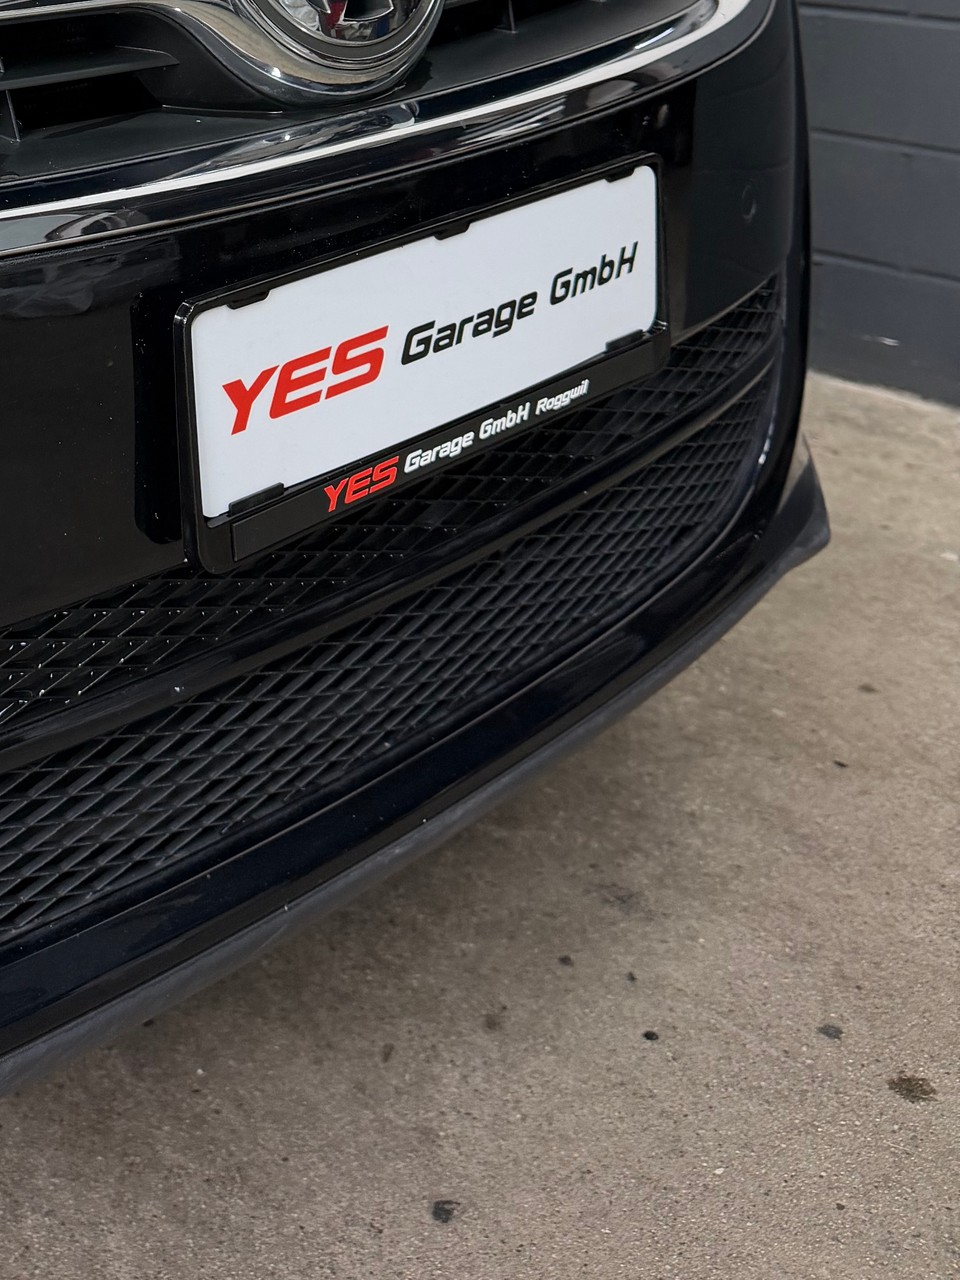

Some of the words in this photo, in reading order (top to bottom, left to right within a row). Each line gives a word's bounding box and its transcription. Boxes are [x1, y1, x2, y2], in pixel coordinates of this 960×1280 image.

[222, 325, 389, 435] YES
[401, 291, 538, 366] Garage
[550, 241, 639, 306] GmbH
[324, 455, 399, 513] YES
[403, 431, 475, 474] Garage
[478, 401, 531, 440] GmbH
[535, 379, 590, 415] Roggwil
